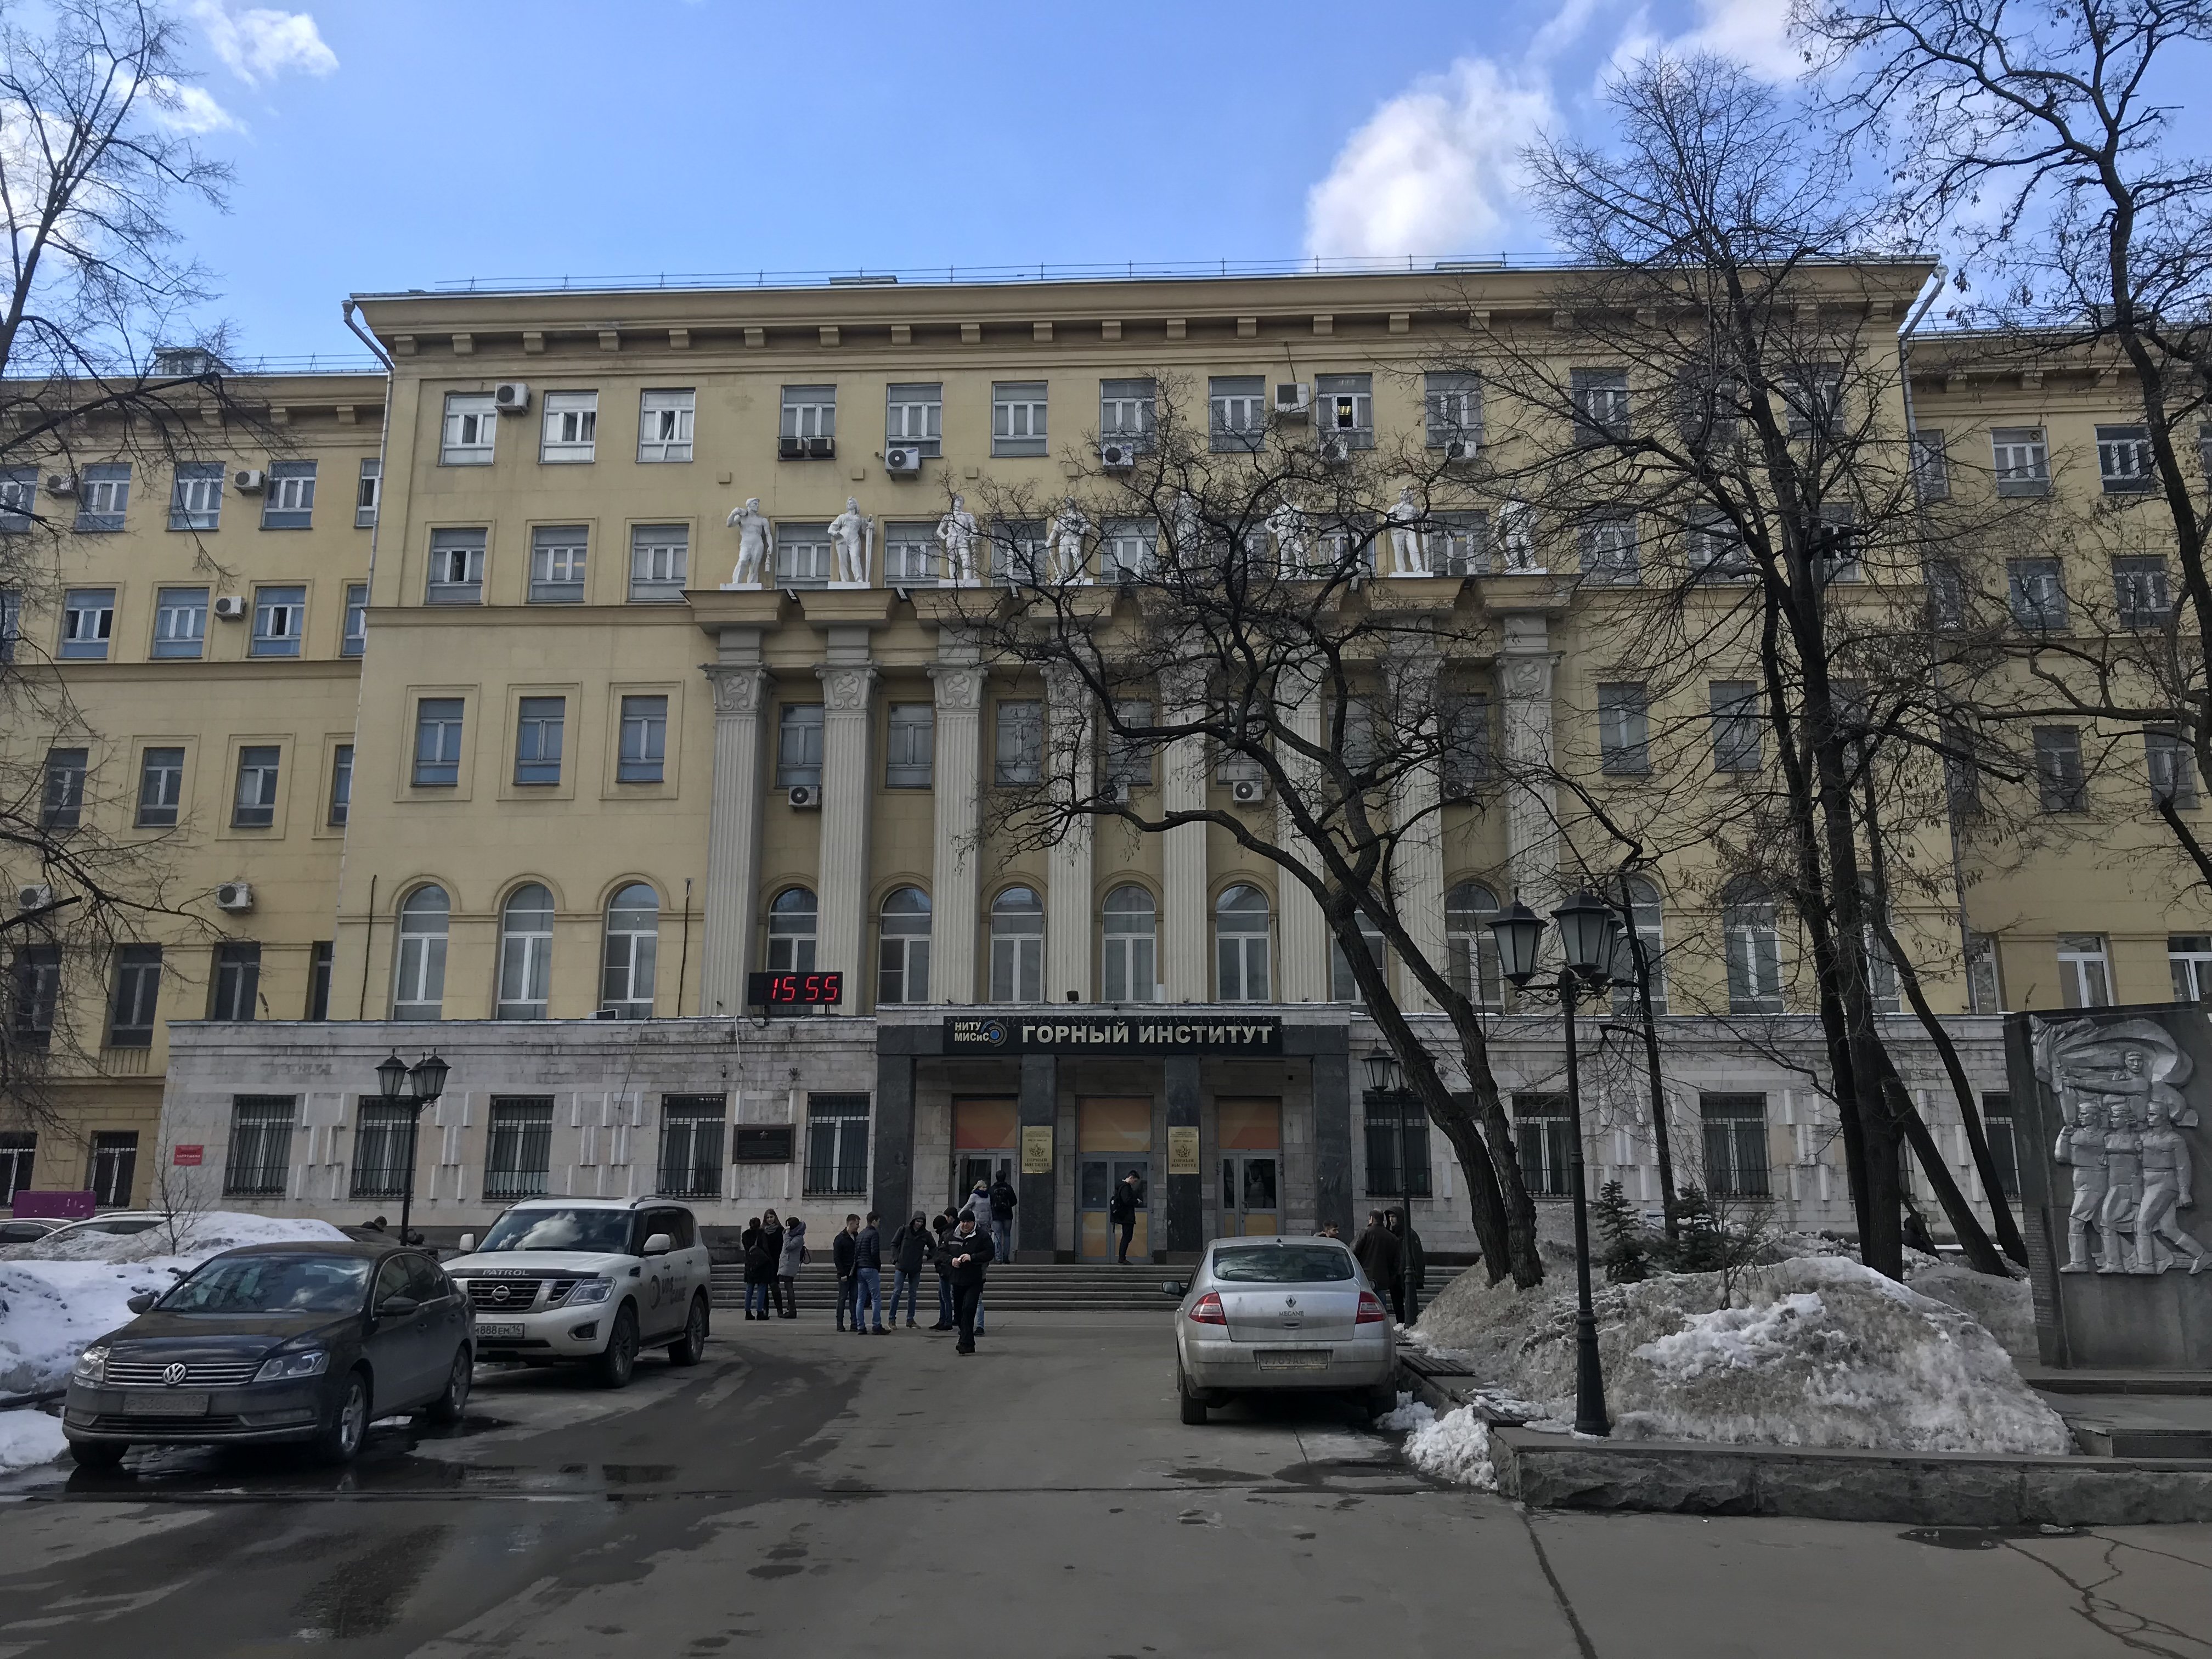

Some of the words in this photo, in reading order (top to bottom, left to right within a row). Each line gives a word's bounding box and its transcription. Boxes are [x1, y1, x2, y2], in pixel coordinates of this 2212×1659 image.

[955, 1022, 981, 1031] НИТУ
[955, 1032, 989, 1041] МИСиС
[1022, 1022, 1128, 1043] ГОРНЫЙ
[1139, 1025, 1273, 1043] ИНСТИТУТ
